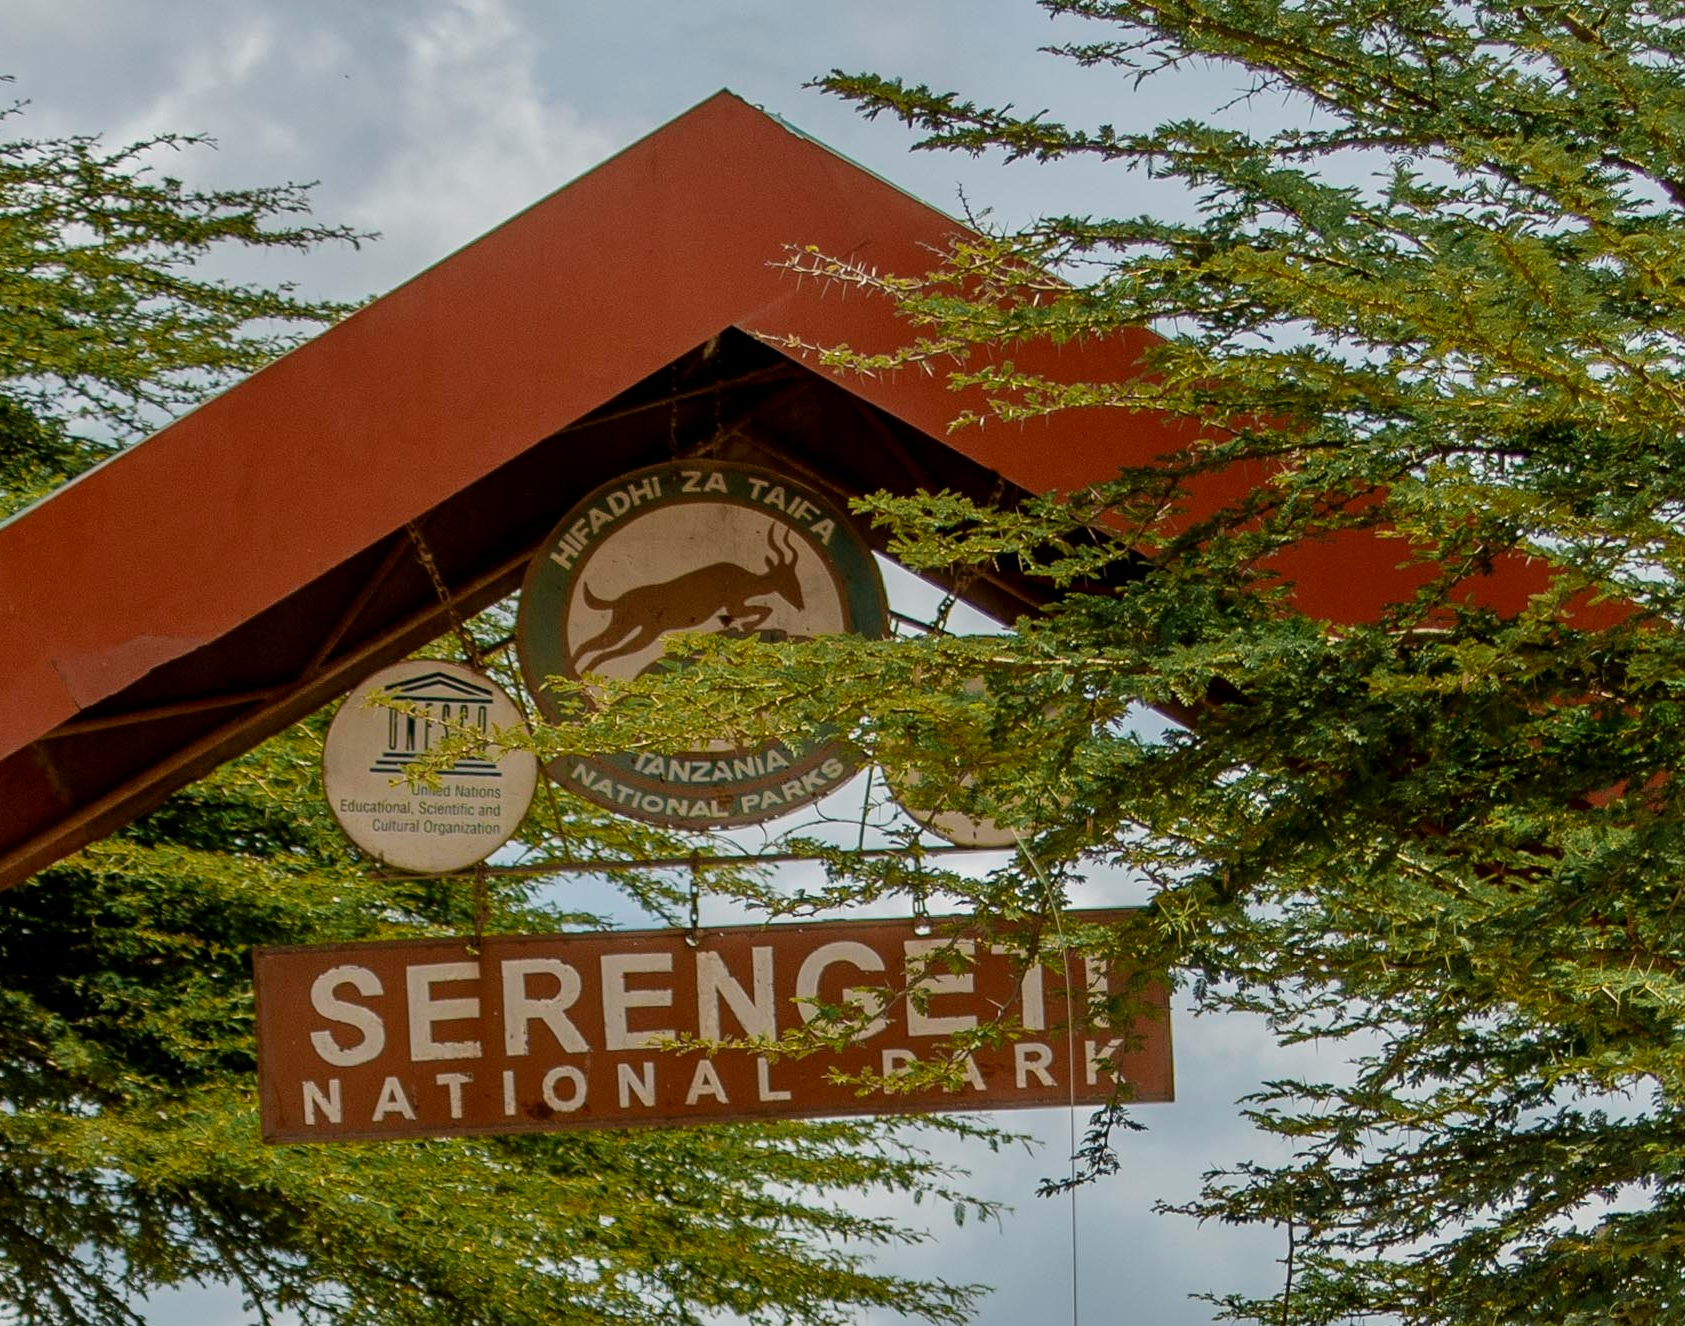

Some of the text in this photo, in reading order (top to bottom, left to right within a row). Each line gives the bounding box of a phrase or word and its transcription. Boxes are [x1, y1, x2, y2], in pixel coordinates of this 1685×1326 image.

[550, 470, 836, 571] HIFADHI ZA TAIFA
[570, 758, 845, 818] NATIONAL PARKS
[632, 749, 790, 783] TANZANIA
[340, 800, 501, 817] Educational, Scientific and
[455, 785, 501, 798] Nations
[372, 819, 501, 836] Cultural Organization
[310, 938, 1111, 1067] SERENGETI
[302, 1057, 792, 1125] NATIONAL
